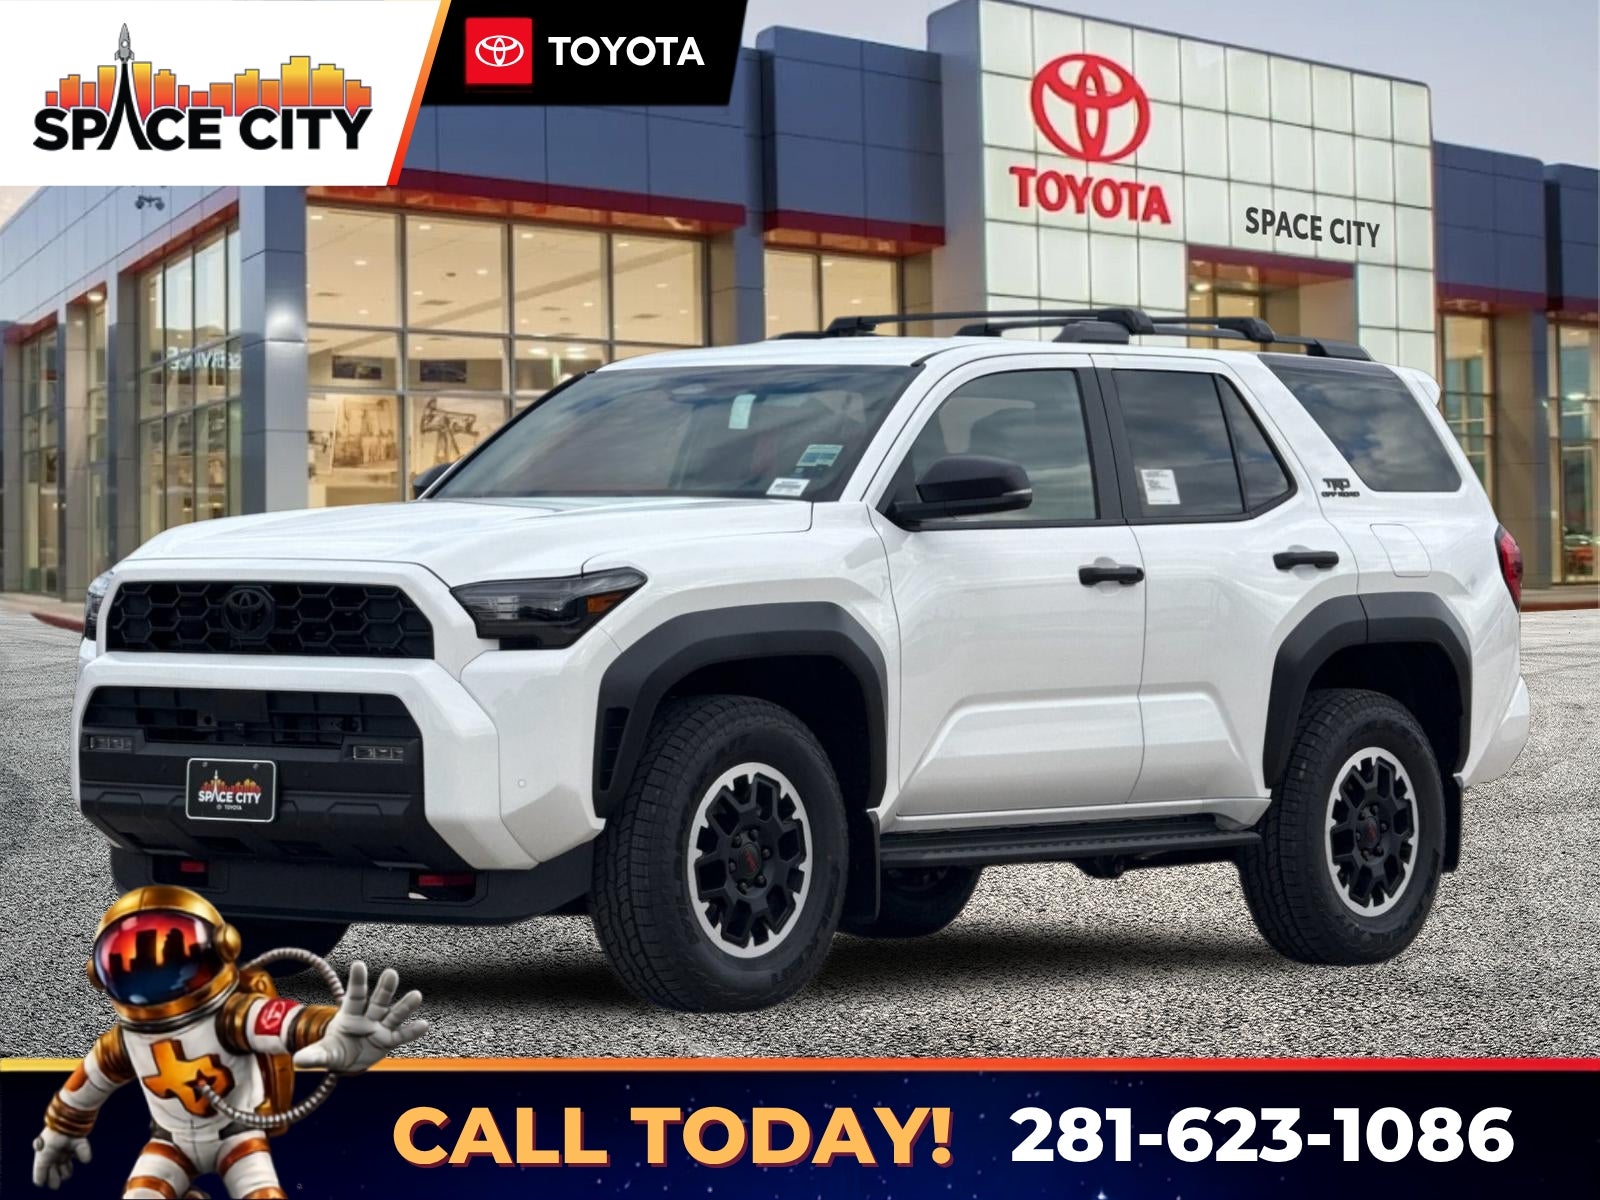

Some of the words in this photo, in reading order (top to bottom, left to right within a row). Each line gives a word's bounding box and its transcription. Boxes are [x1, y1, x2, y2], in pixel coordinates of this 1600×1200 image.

[1009, 166, 1171, 224] TOYOTA
[1245, 206, 1323, 242] SPACE
[1329, 218, 1380, 248] CITY
[198, 790, 233, 803] SPACE
[235, 792, 261, 804] CITY
